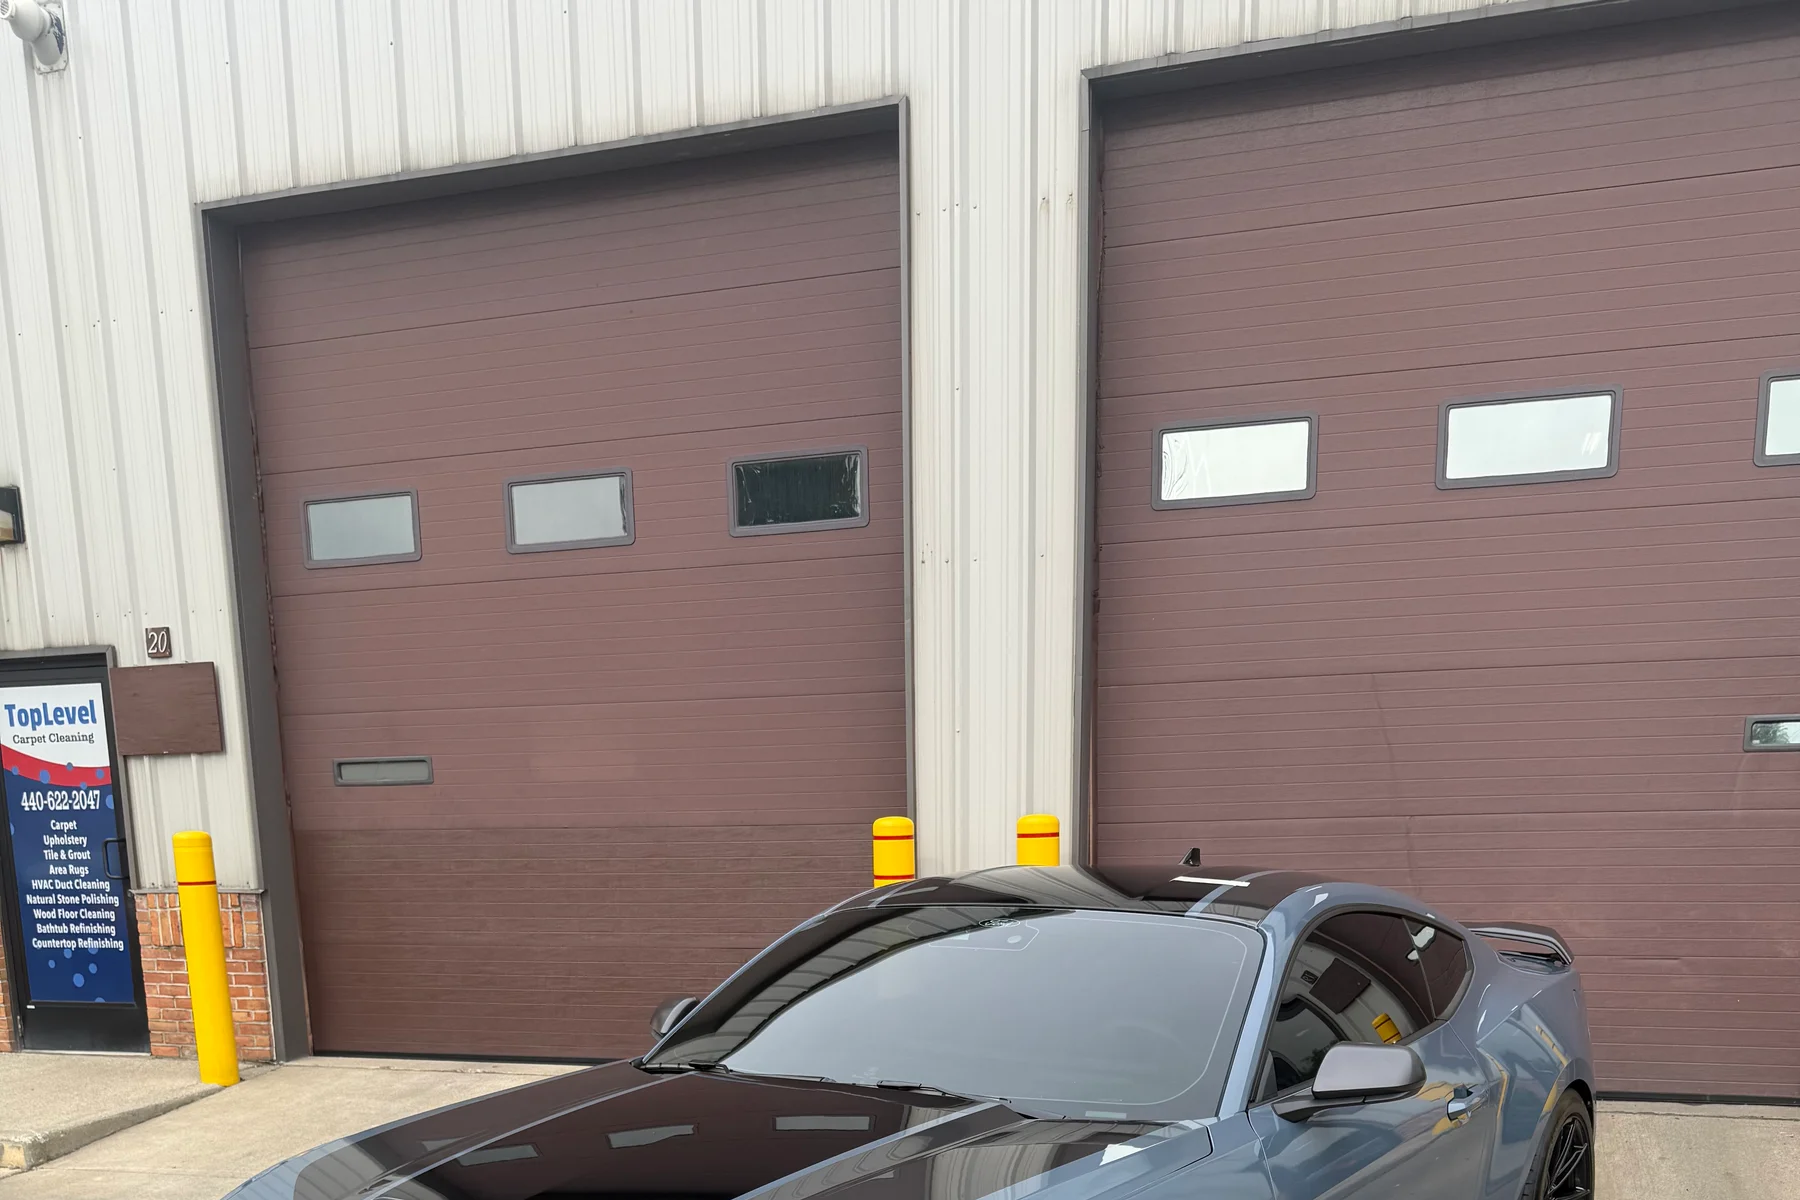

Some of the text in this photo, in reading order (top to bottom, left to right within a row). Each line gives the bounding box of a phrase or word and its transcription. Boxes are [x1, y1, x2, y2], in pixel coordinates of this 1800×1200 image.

[148, 630, 168, 654] 20
[4, 699, 97, 731] TopLevel
[12, 731, 95, 746] Carpet Cleaning
[21, 790, 100, 811] 440-622-2047
[50, 820, 77, 833] Carpet
[43, 834, 87, 848] Upholstery
[43, 849, 91, 860] Tile & Grout
[49, 864, 89, 877] Area Rugs
[31, 879, 110, 892] HVAC Duct Cleaning
[26, 894, 120, 907] Natural Stone Polishing
[33, 908, 116, 921] Wood Floor Cleaning
[37, 922, 116, 936] Bathtub Refinishing
[32, 938, 124, 951] Countertop Refinishing
